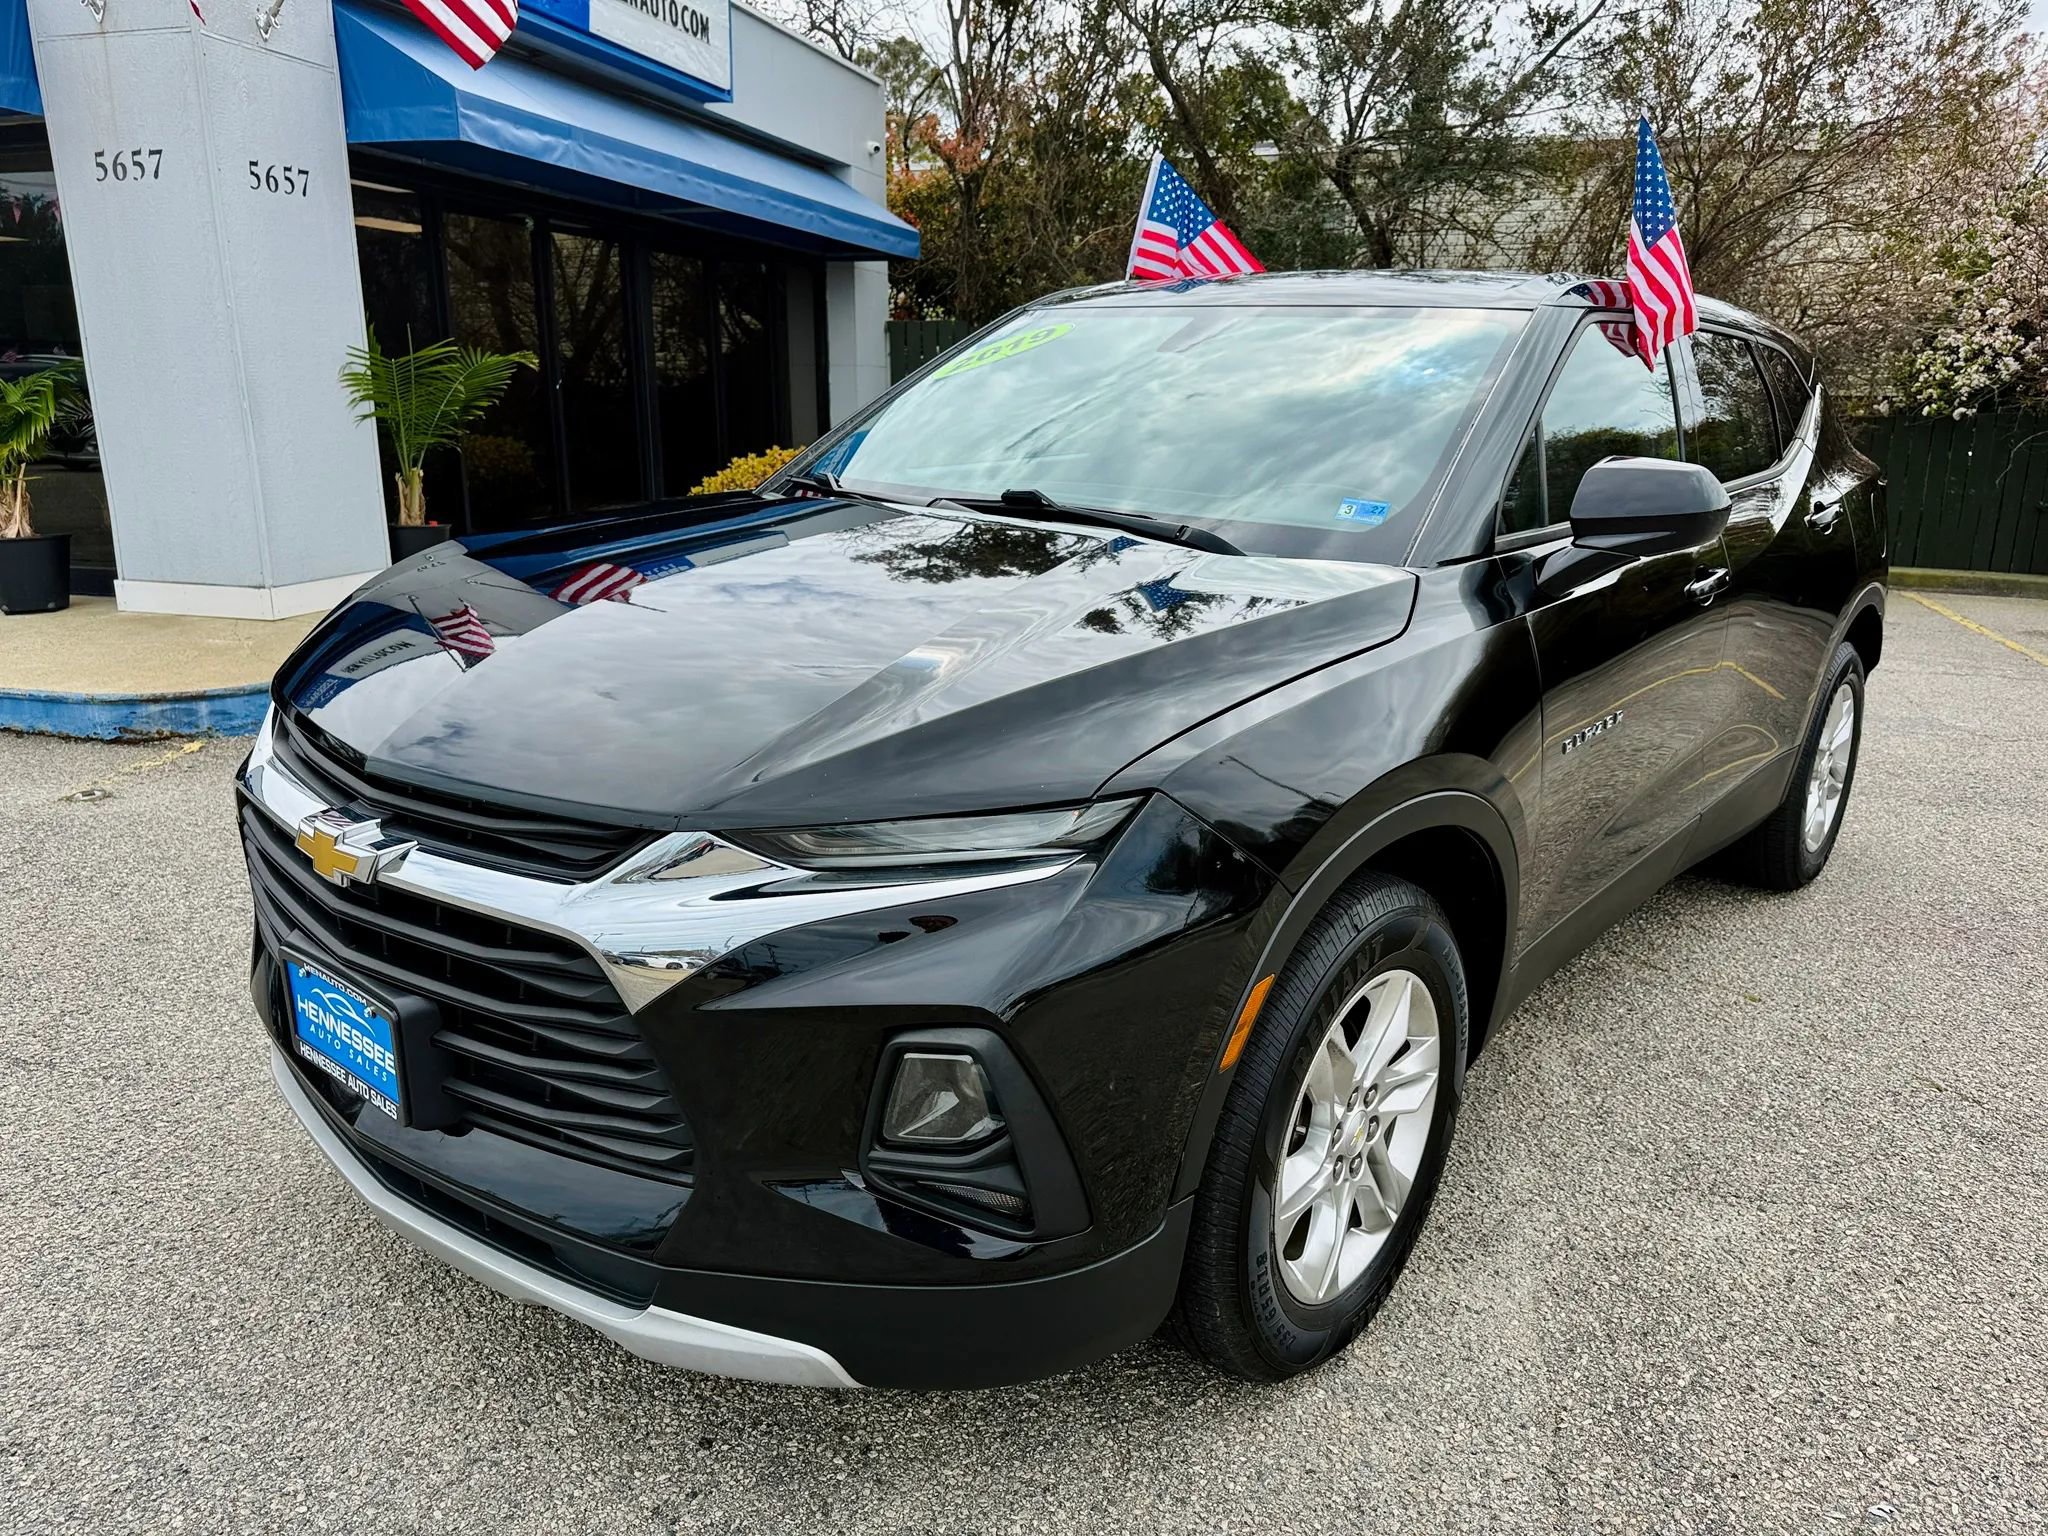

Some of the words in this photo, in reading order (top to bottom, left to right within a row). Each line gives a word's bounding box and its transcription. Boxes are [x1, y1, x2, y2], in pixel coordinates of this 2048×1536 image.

[622, 0, 712, 46] AUTO.COM
[95, 148, 163, 182] 5657
[249, 160, 310, 197] 5657
[1344, 505, 1353, 514] 3
[1561, 709, 1624, 755] BLAZER
[303, 962, 367, 1007] HENAUTO.COM
[297, 994, 396, 1075] HENNESSEE
[310, 1024, 342, 1050] AUTO
[349, 1048, 388, 1082] SALES
[300, 1042, 346, 1083] HENNESSEE
[348, 1073, 370, 1100] AUTO
[370, 1091, 398, 1120] SALES
